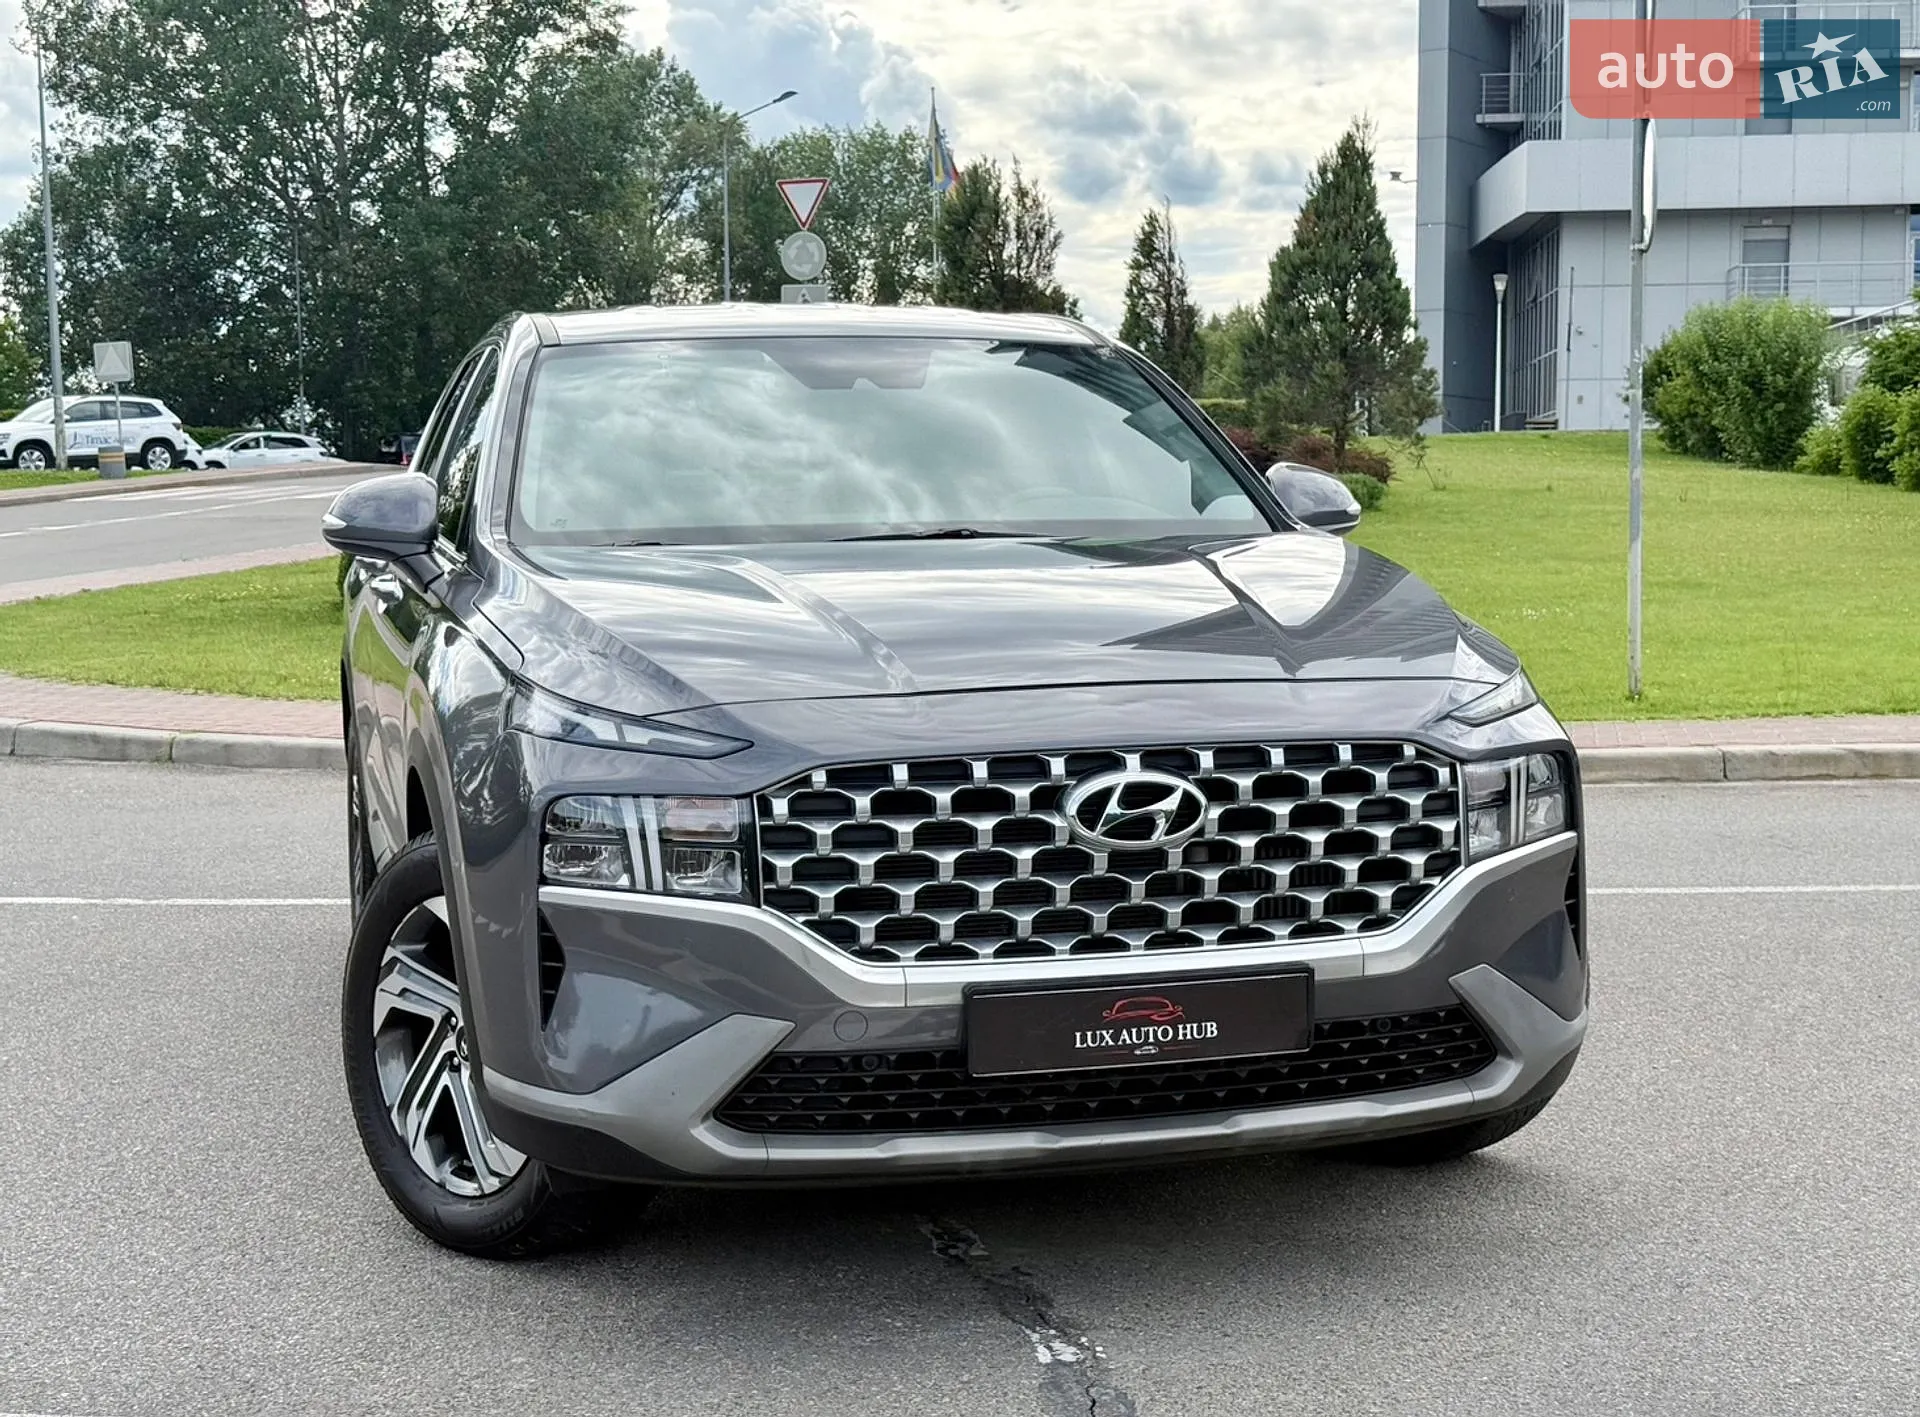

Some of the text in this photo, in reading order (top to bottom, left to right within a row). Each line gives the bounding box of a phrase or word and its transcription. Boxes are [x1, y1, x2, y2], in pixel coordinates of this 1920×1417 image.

[1075, 1021, 1218, 1048] LUX AUTO HUB
